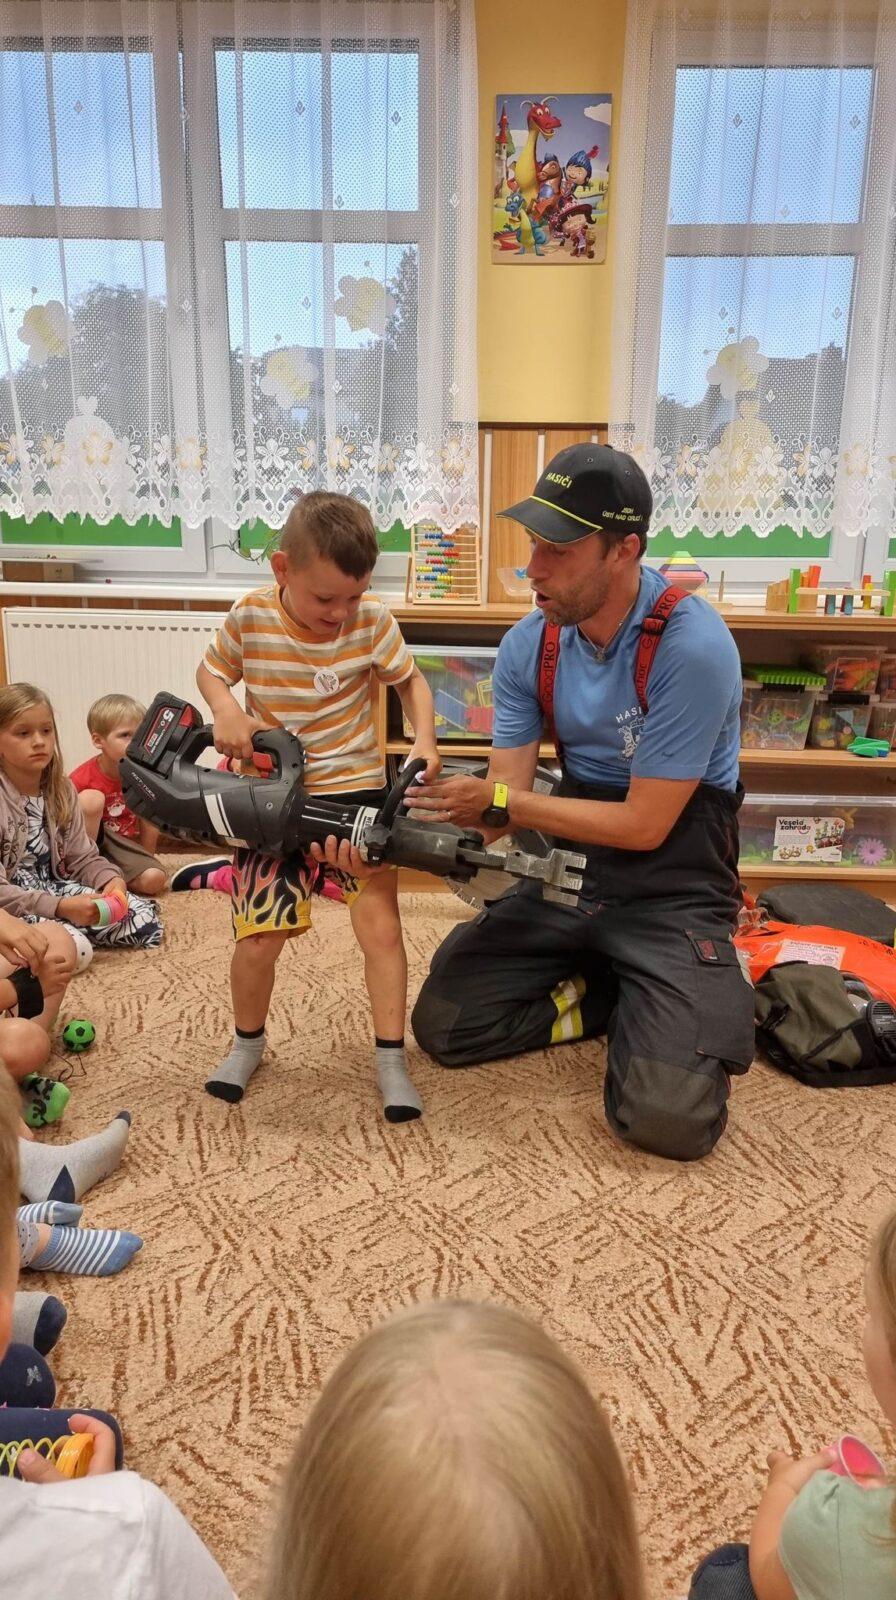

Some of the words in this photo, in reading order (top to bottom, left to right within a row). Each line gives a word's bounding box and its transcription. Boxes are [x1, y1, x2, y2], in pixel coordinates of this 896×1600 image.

[545, 472, 573, 489] HASIČI
[656, 593, 678, 617] PRO
[615, 706, 642, 723] HASI
